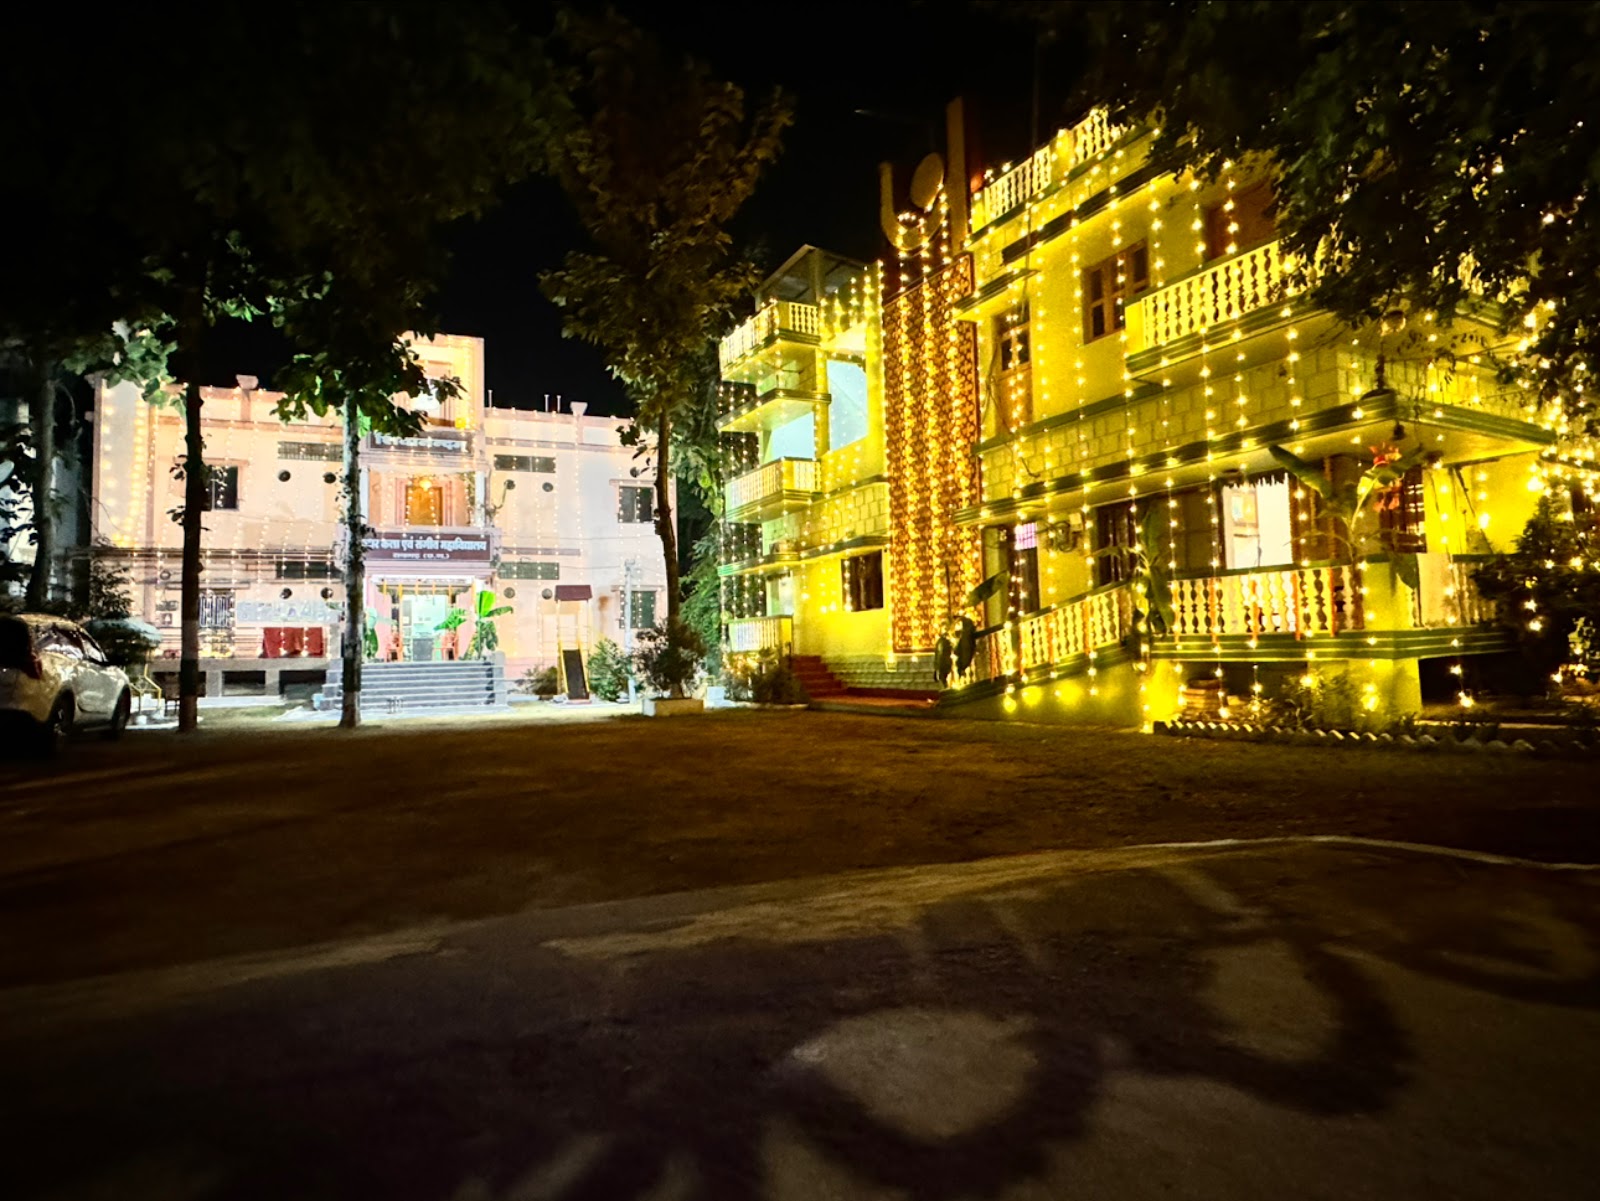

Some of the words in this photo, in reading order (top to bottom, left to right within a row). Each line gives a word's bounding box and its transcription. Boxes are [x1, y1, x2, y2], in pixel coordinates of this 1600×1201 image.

[402, 535, 414, 552] एवं
[416, 536, 439, 550] संगीत
[441, 536, 487, 552] महाविद्यालय
